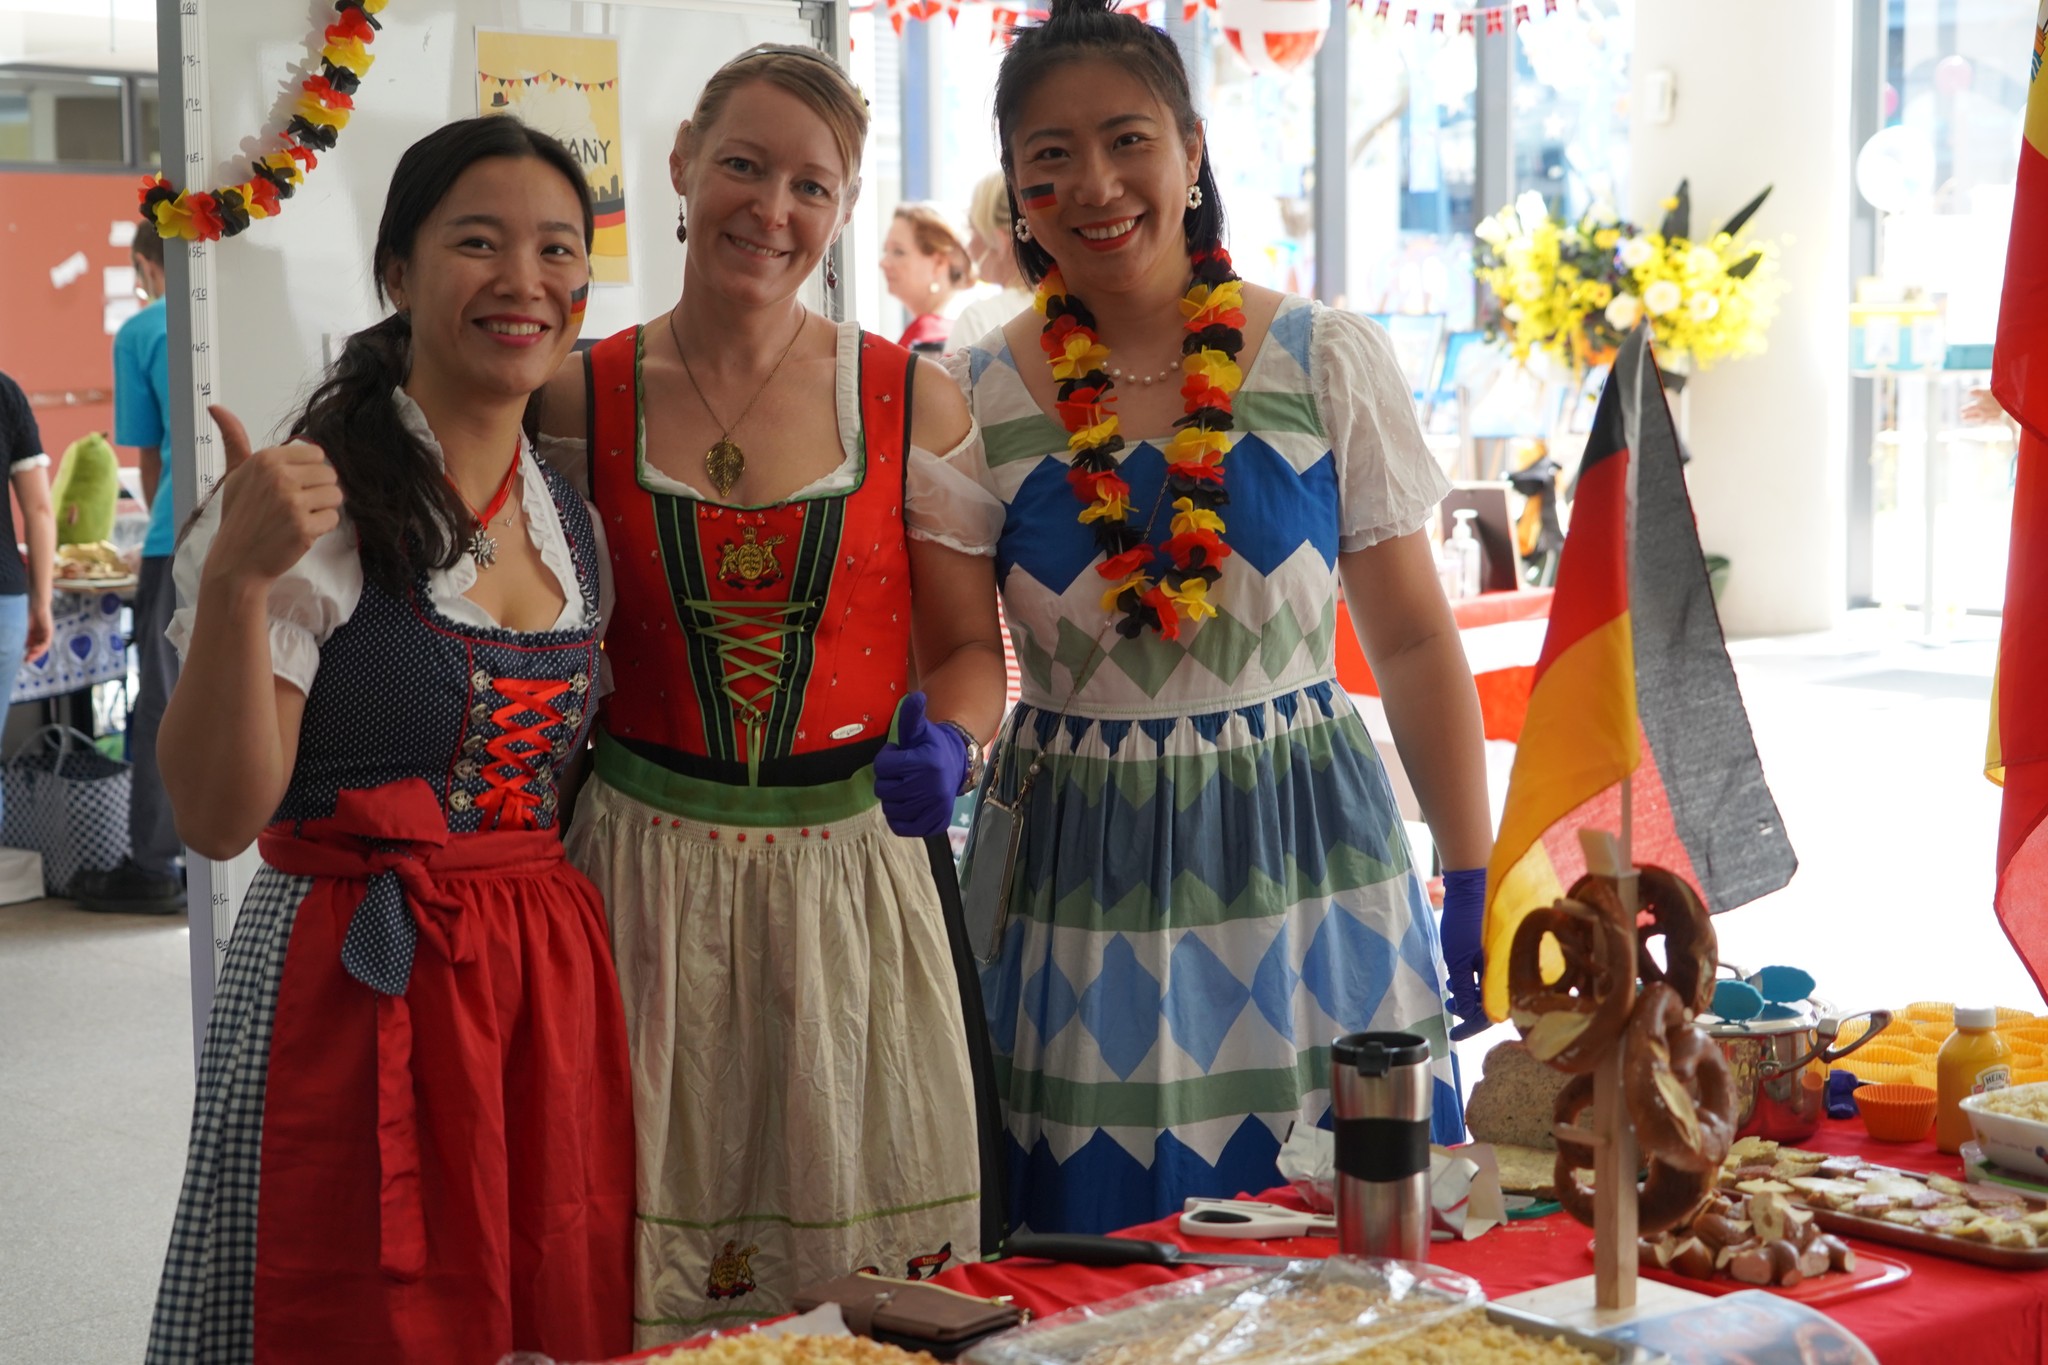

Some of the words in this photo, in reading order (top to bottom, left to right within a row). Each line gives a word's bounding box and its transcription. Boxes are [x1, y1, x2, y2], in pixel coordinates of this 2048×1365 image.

[559, 138, 611, 165] ANY
[189, 246, 202, 258] 155
[191, 287, 207, 298] 150
[192, 341, 206, 352] 145
[196, 434, 212, 445] 135
[1985, 1072, 2006, 1085] HEINZ
